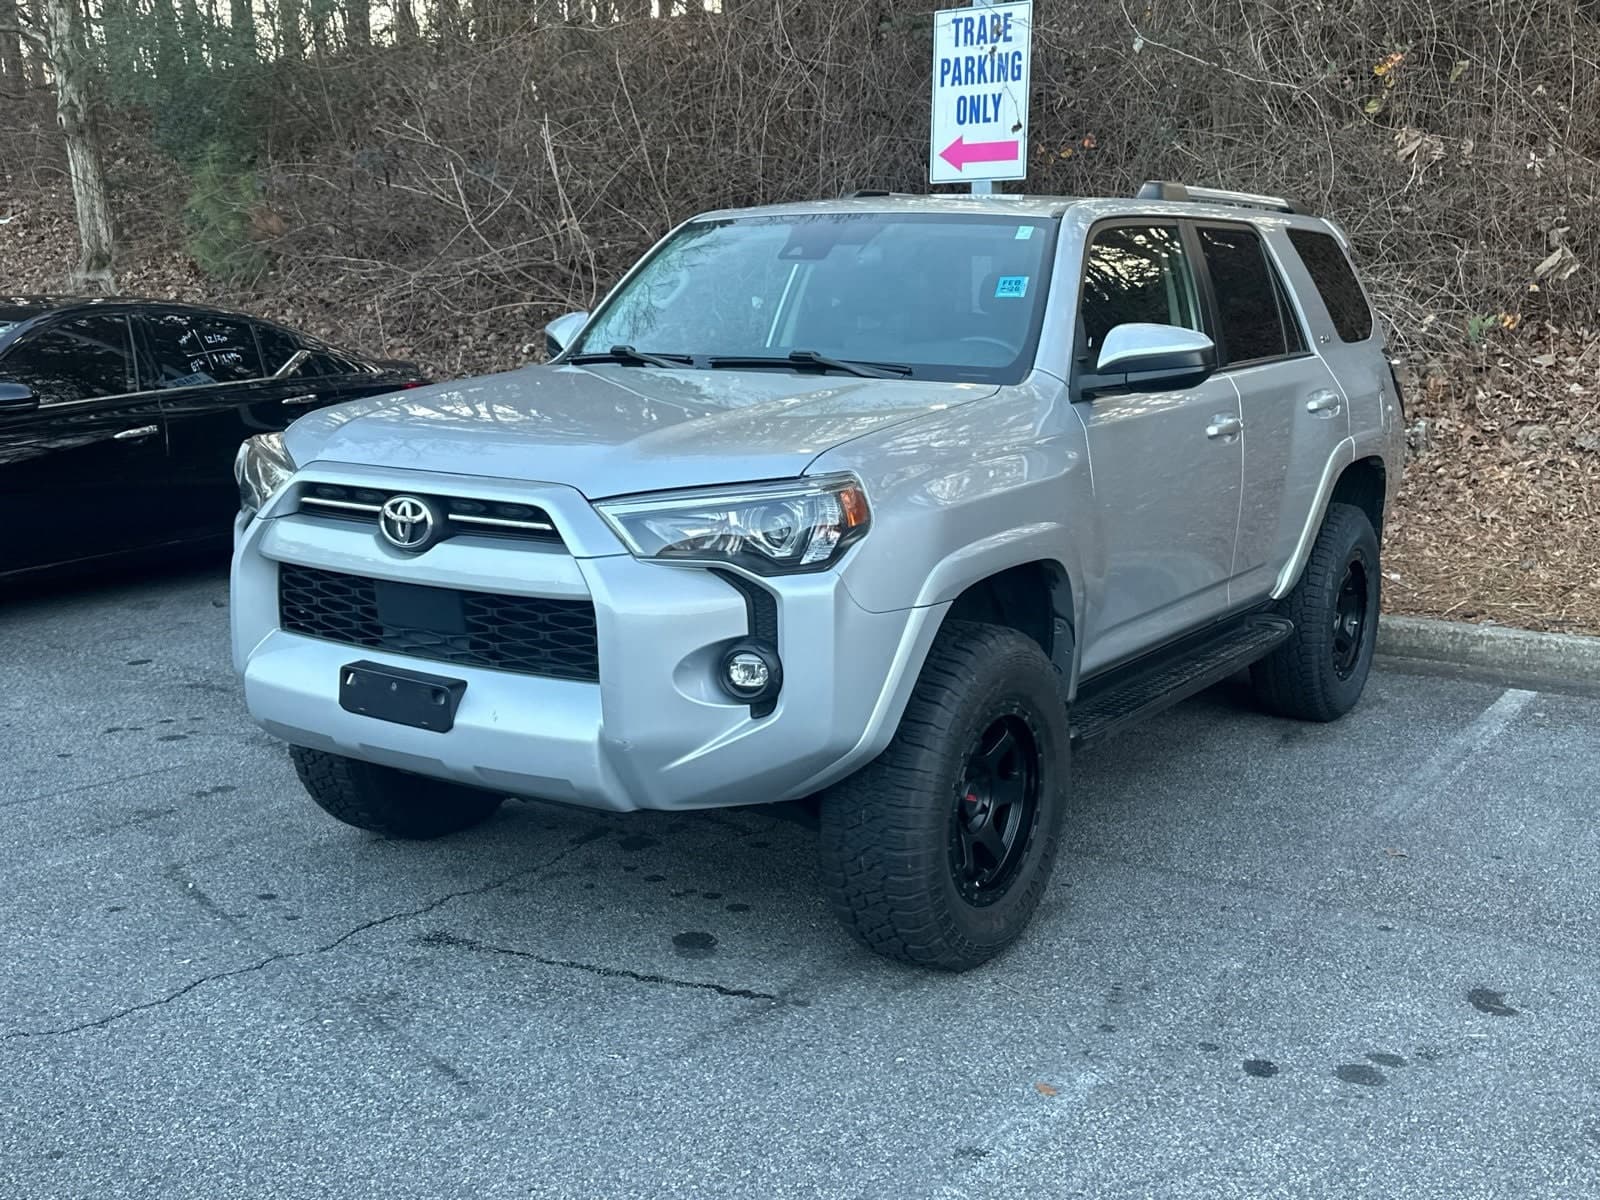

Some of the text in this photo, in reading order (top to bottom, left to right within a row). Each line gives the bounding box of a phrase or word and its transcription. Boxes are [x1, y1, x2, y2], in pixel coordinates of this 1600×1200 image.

[952, 12, 1013, 47] TRADE
[940, 51, 1022, 87] PARKING
[956, 93, 1002, 126] ONLY
